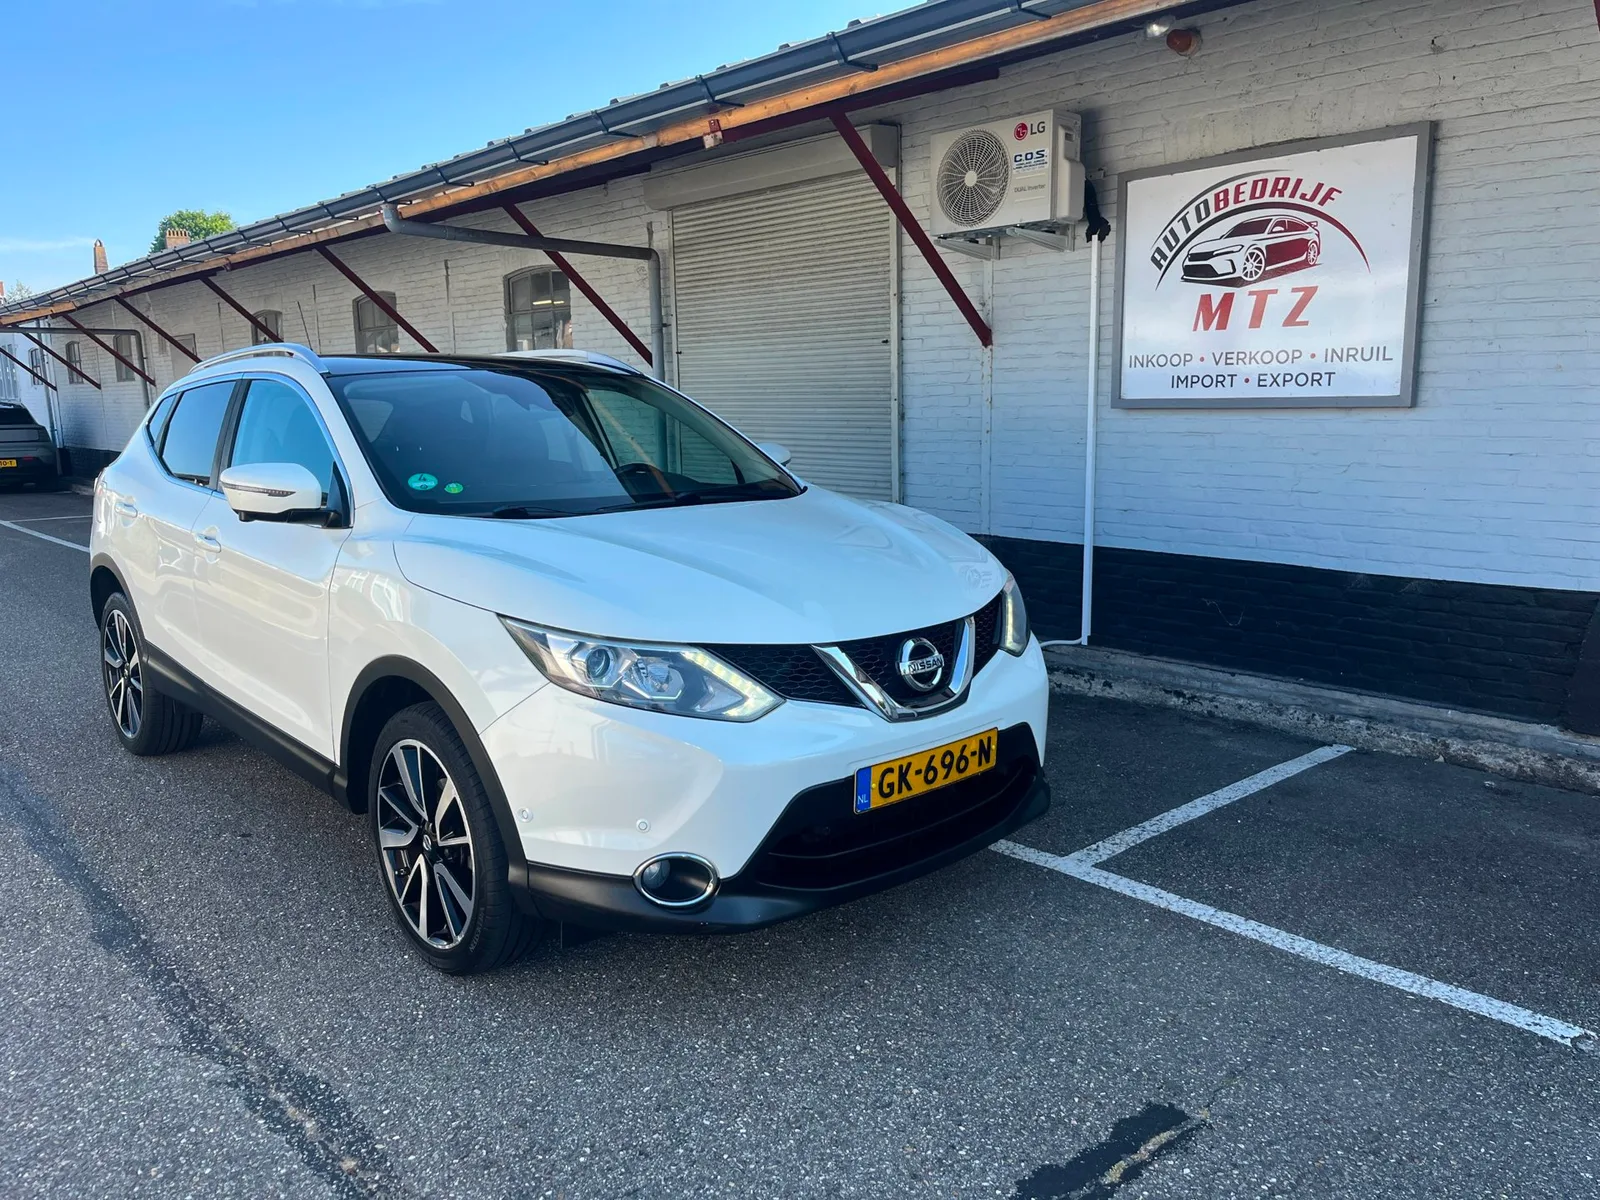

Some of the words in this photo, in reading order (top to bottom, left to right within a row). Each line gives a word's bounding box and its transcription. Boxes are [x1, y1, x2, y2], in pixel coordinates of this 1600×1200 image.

[1030, 121, 1045, 135] LG
[1150, 176, 1343, 272] AUTOBEDRIJF
[1192, 285, 1319, 332] MTZ
[1128, 353, 1194, 369] INKOOP
[1212, 349, 1303, 366] VERKOOP
[1324, 345, 1394, 364] INRUIL
[1170, 373, 1238, 389] IMPORT
[1257, 371, 1336, 388] EXPORT
[908, 655, 944, 674] NISSAN
[878, 736, 992, 799] GK-696-N
[857, 794, 869, 805] NL
